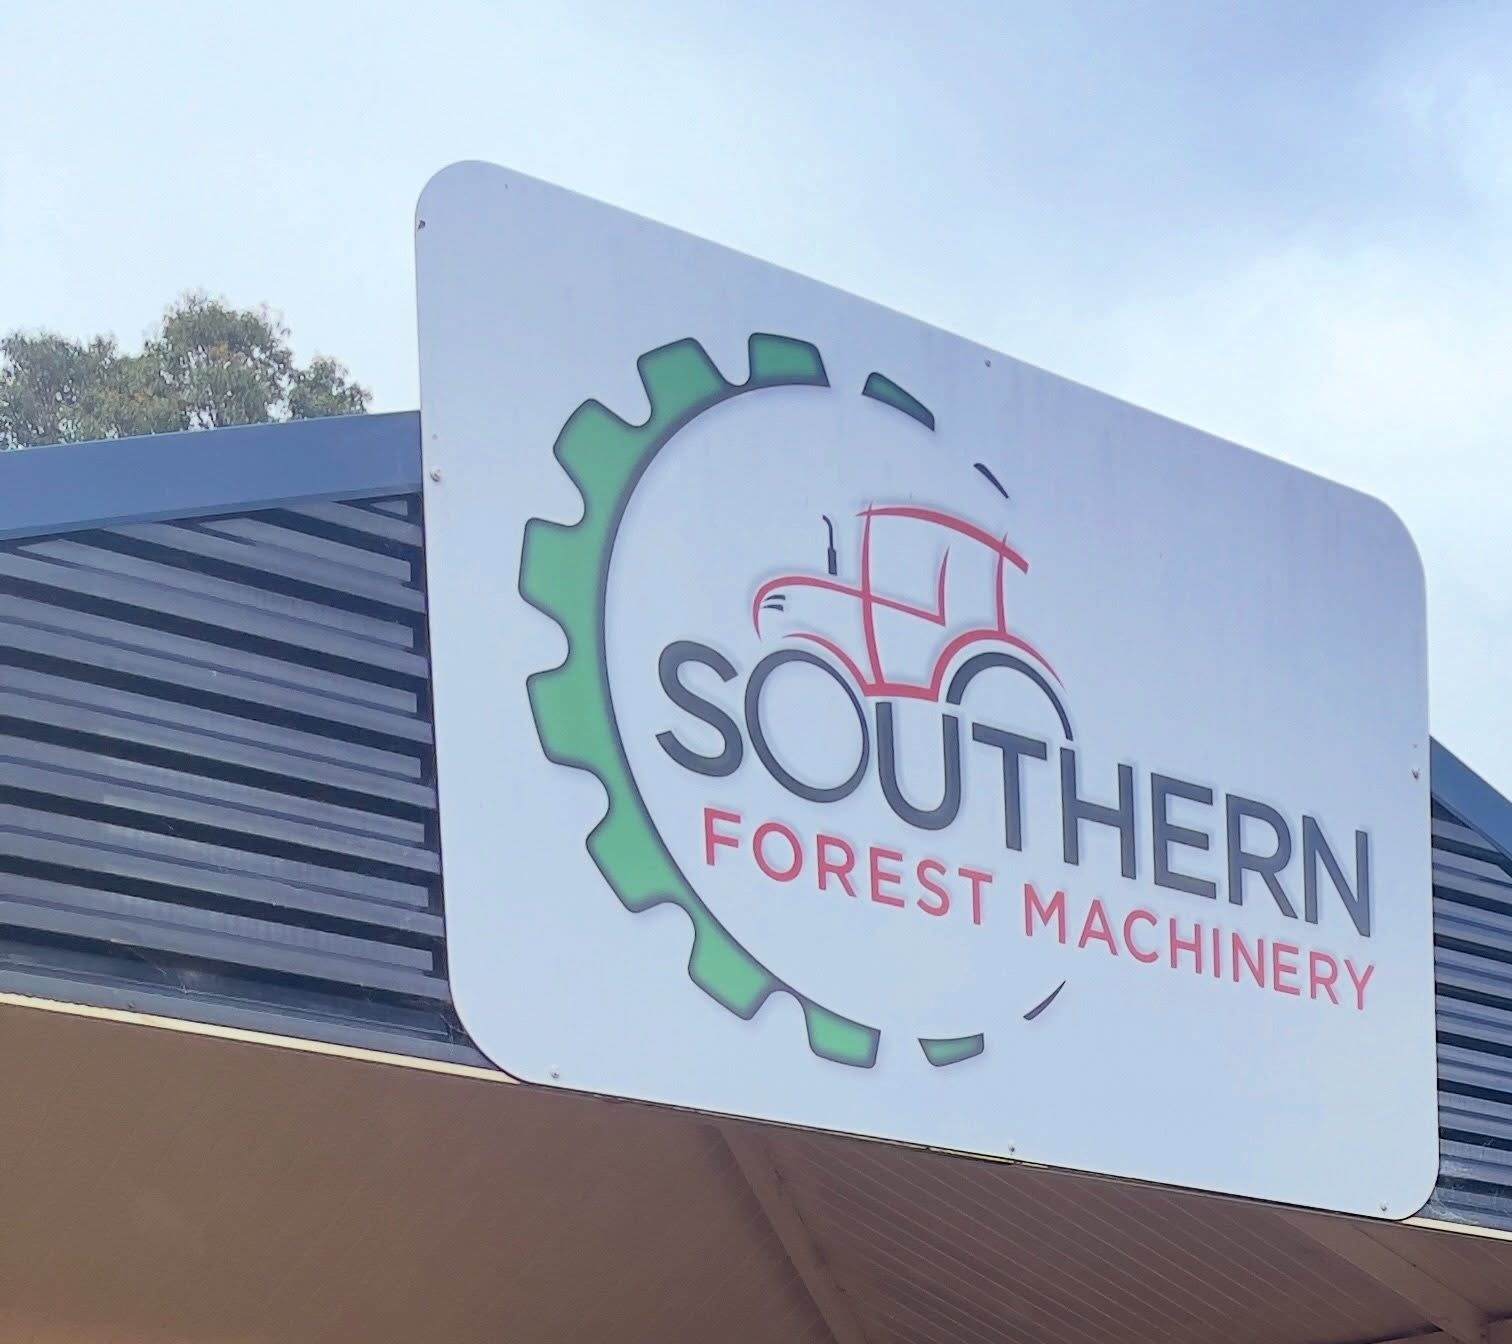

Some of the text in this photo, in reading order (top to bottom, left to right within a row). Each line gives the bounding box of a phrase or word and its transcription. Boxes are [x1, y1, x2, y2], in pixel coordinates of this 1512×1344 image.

[656, 640, 1372, 937] SOUTHERN
[703, 806, 1375, 1011] FOREST MACHINERY
